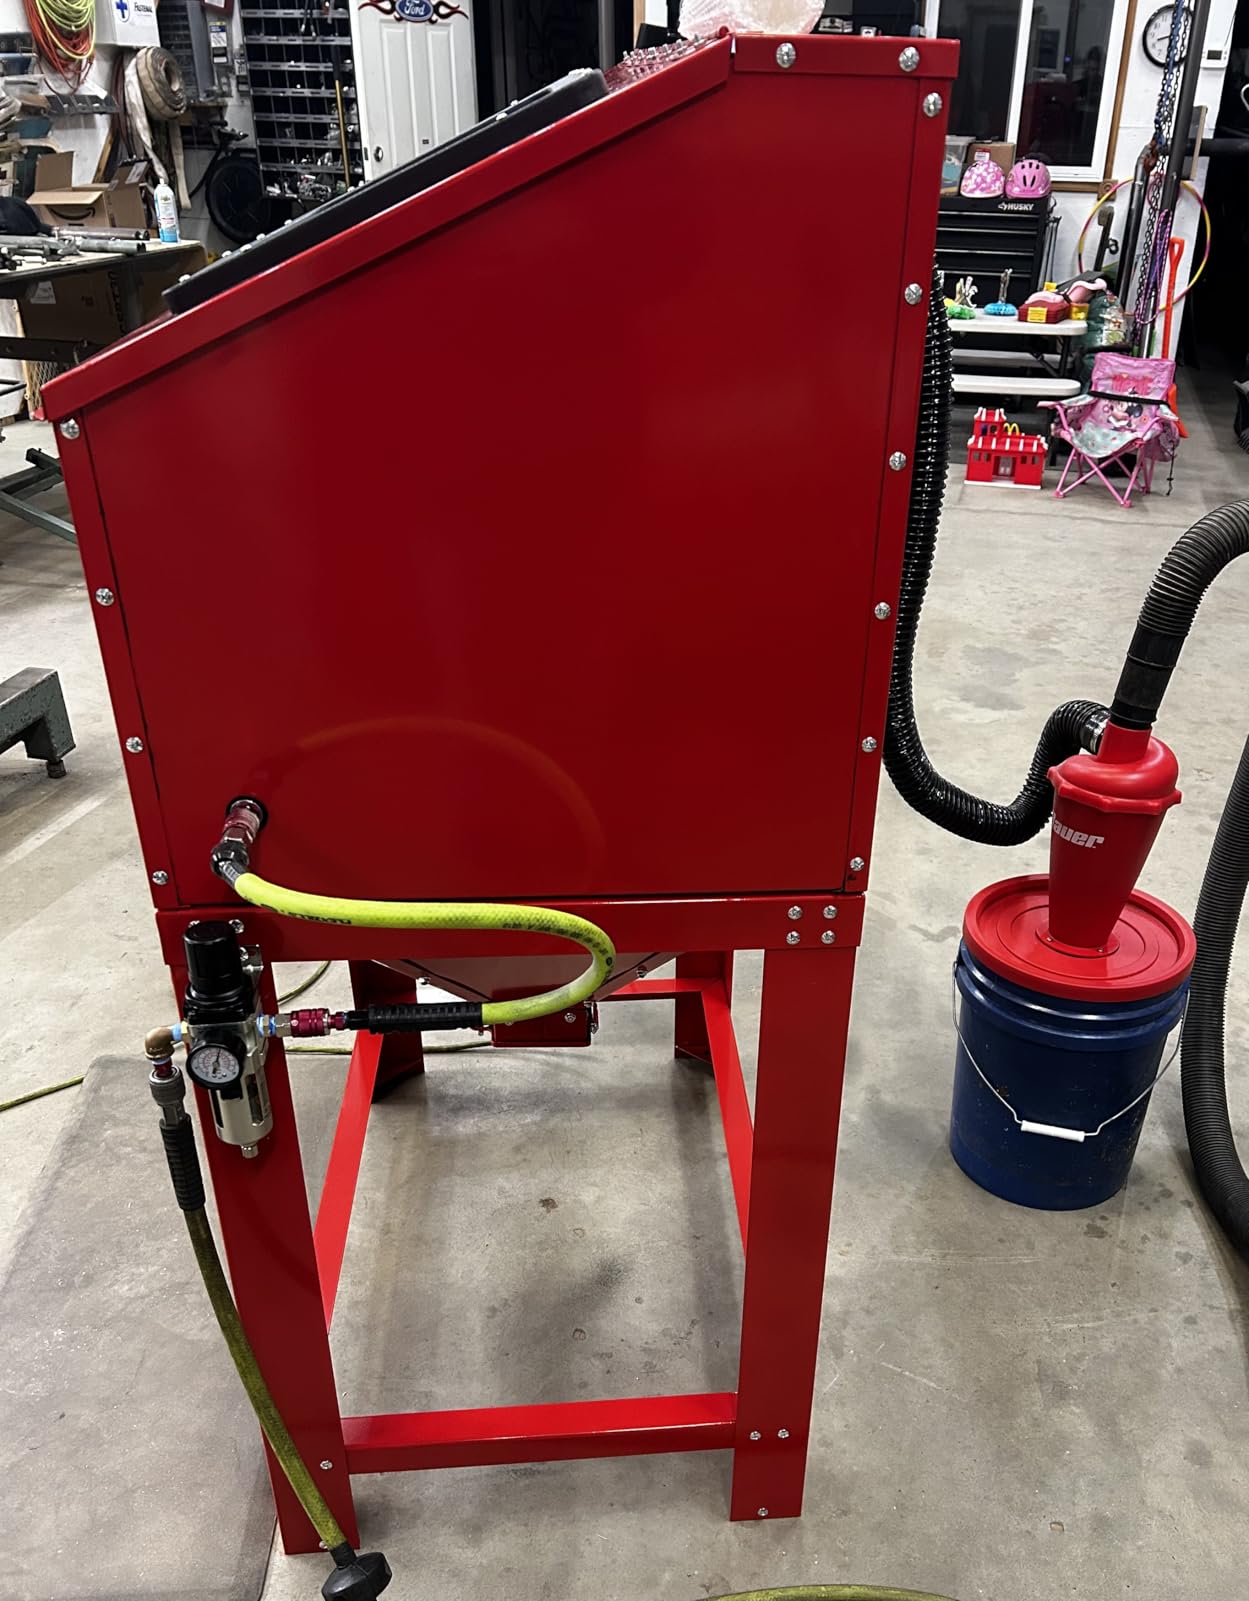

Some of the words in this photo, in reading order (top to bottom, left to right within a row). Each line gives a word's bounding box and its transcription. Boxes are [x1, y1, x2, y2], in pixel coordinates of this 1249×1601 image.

[404, 0, 425, 15] Ford
[1008, 202, 1033, 211] HUSKY
[1053, 813, 1104, 848] auer
